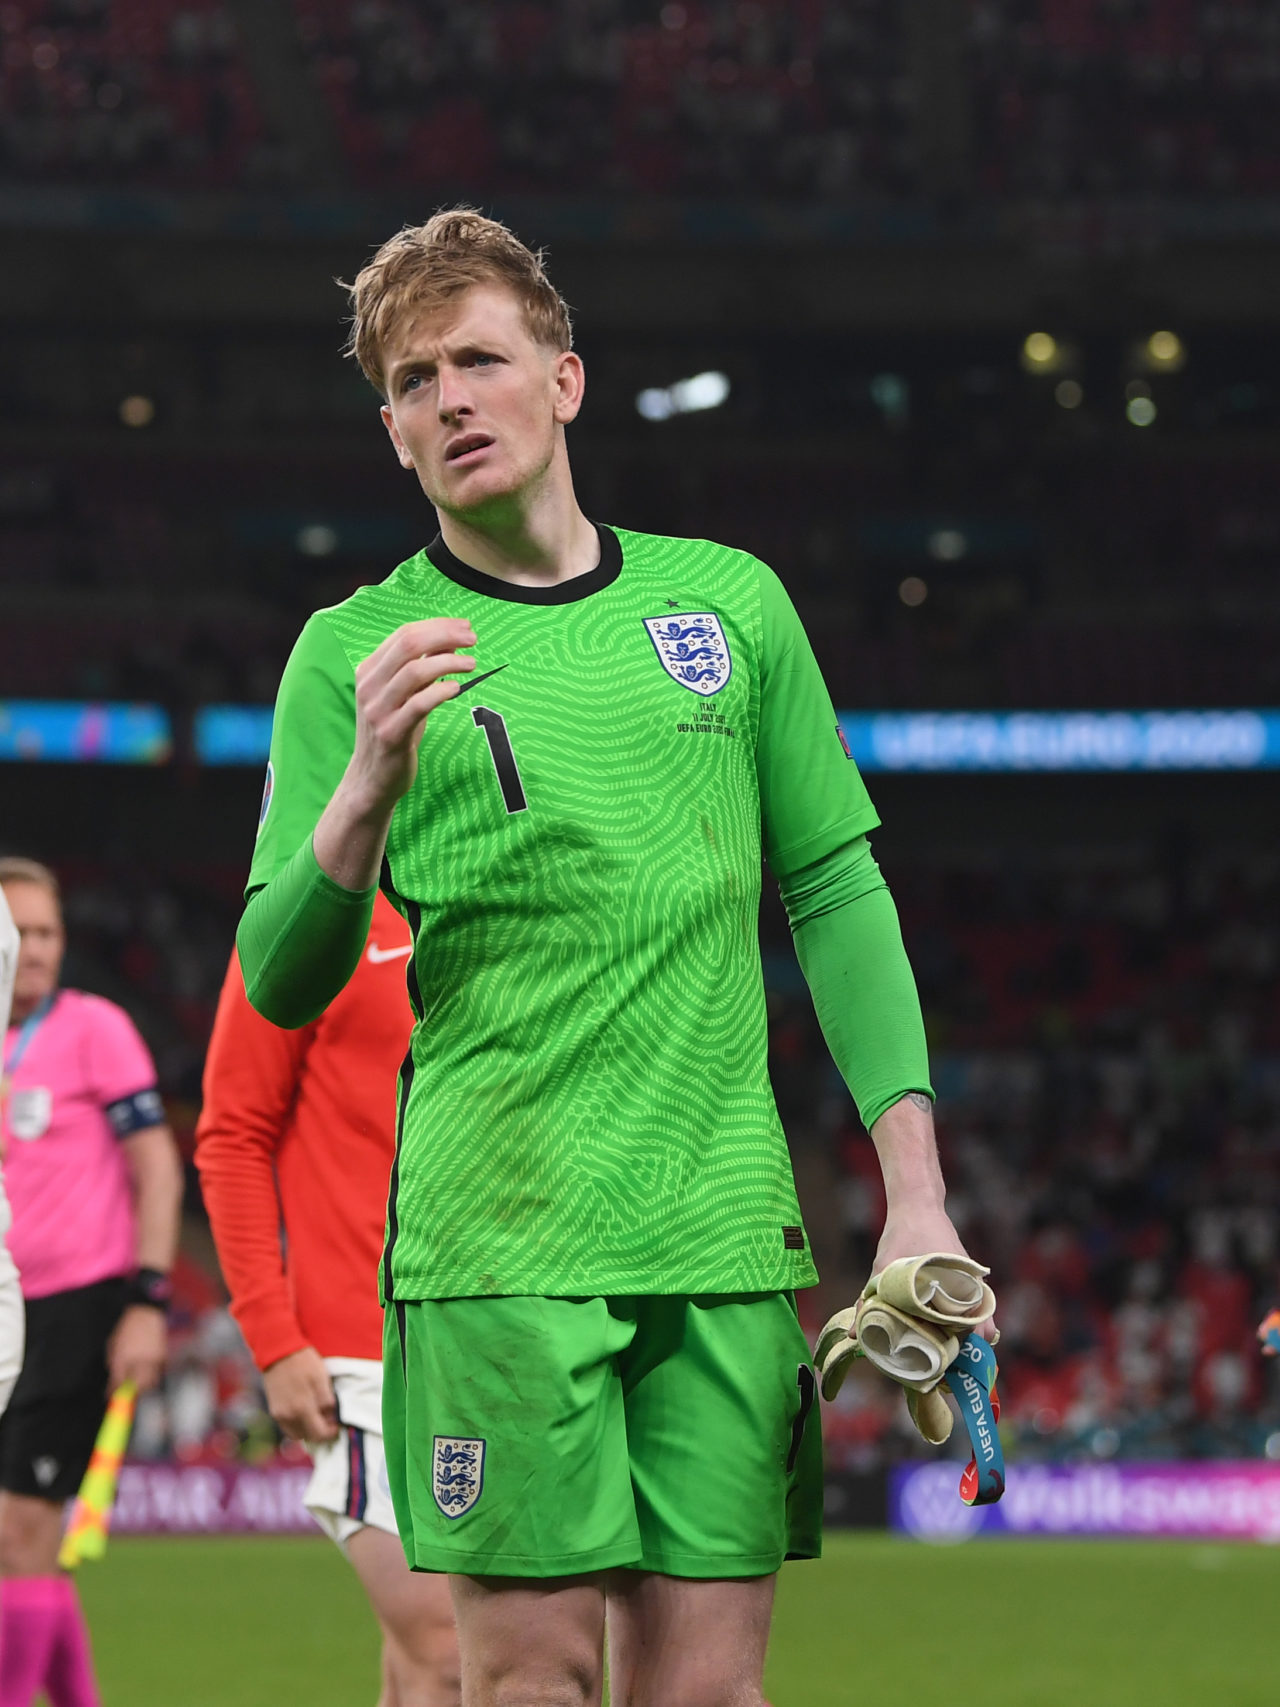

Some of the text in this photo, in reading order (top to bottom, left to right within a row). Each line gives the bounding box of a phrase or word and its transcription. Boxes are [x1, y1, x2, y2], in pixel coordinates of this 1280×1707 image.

[677, 723, 694, 732] UEFA
[696, 723, 712, 733] EURO
[700, 713, 714, 722] JULY
[471, 706, 528, 815] 1
[786, 1363, 815, 1474] 1
